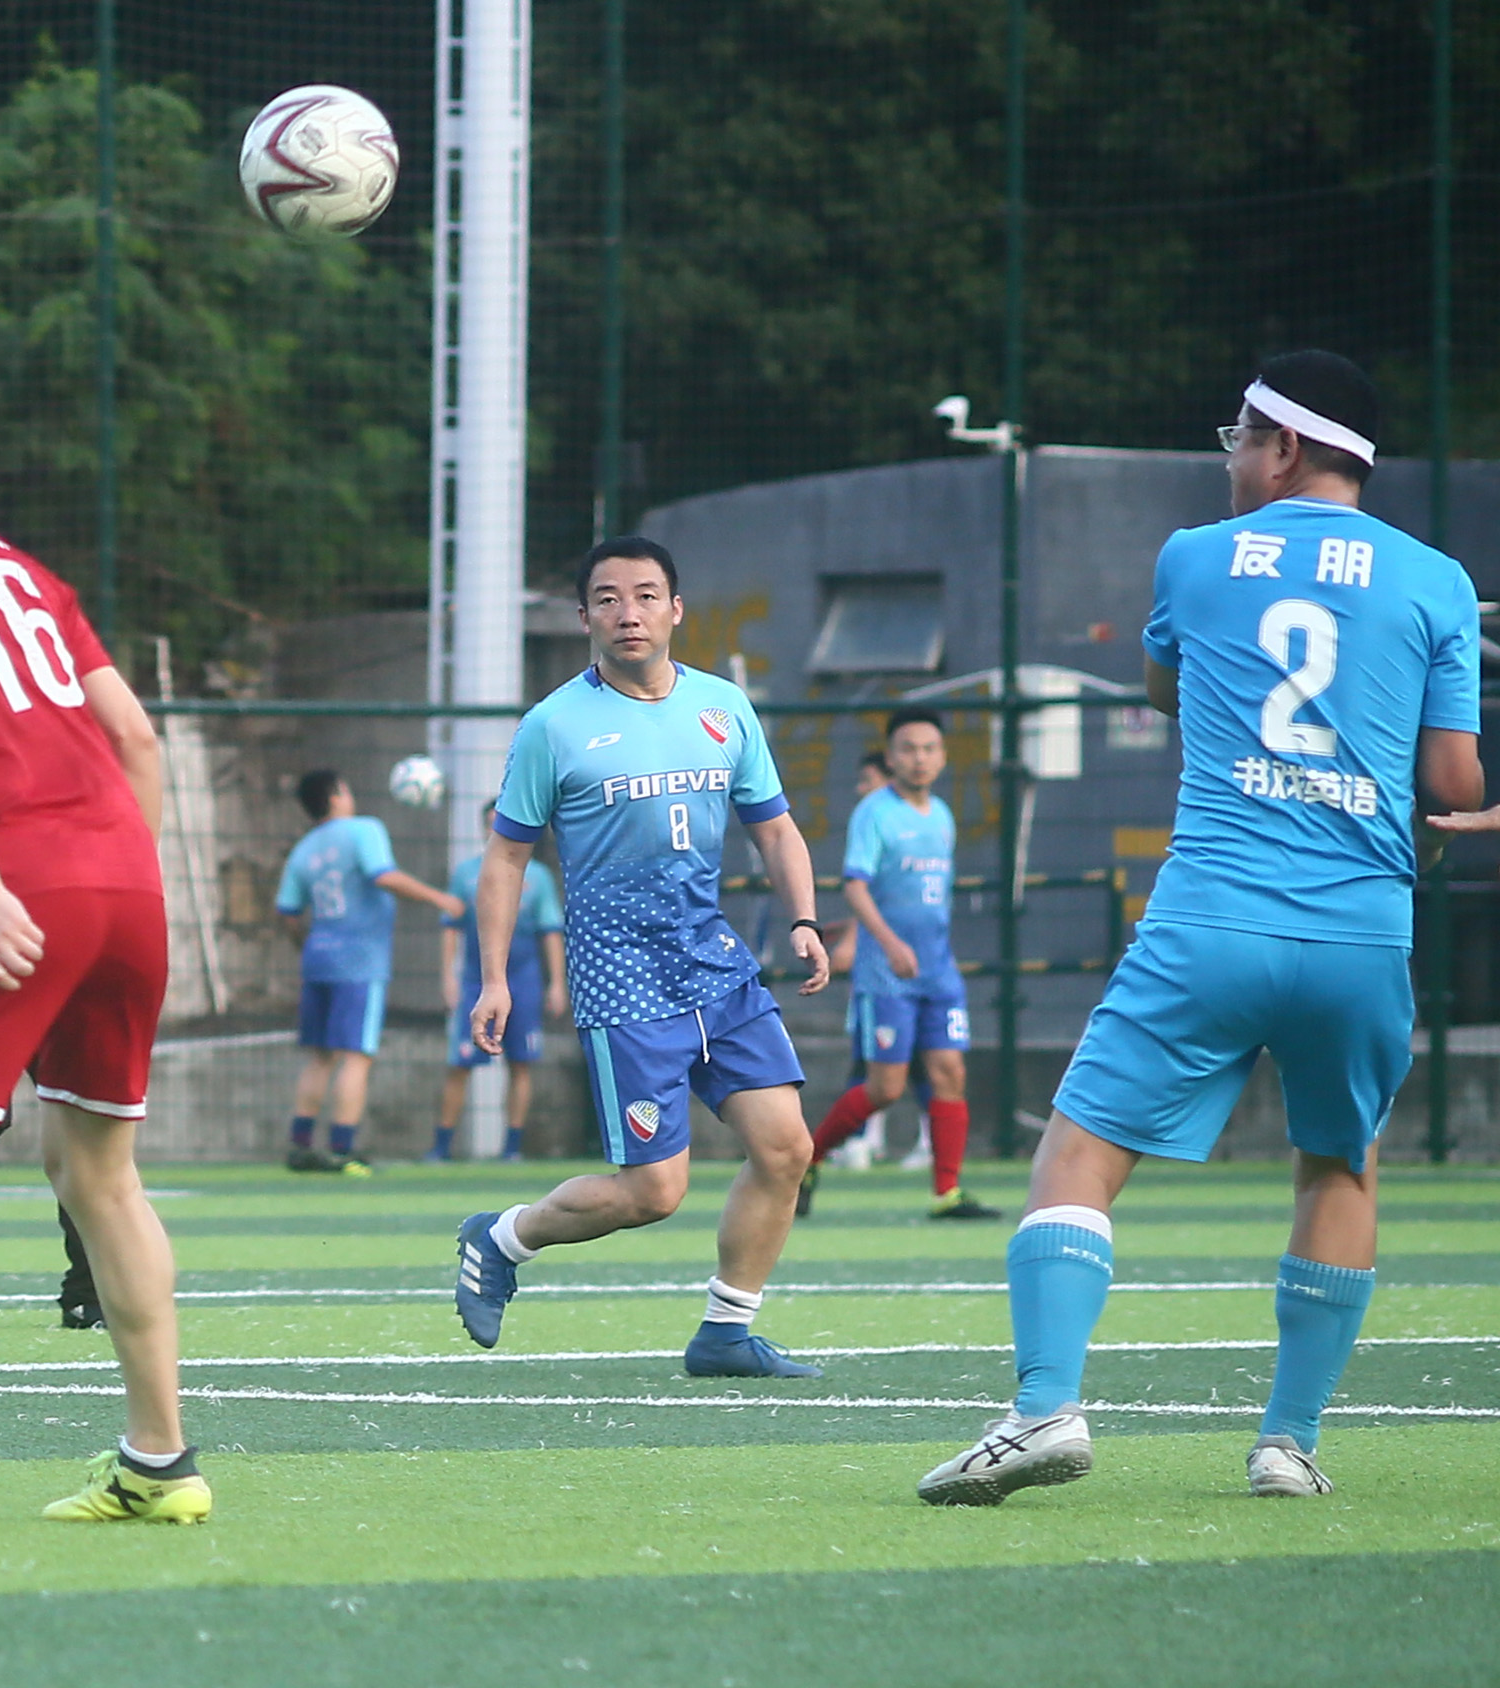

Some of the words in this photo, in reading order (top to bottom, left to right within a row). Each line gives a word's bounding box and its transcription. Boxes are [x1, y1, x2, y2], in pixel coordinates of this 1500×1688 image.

[1257, 598, 1339, 758] 2
[1232, 756, 1378, 817] 书戏英语
[668, 802, 691, 851] 8
